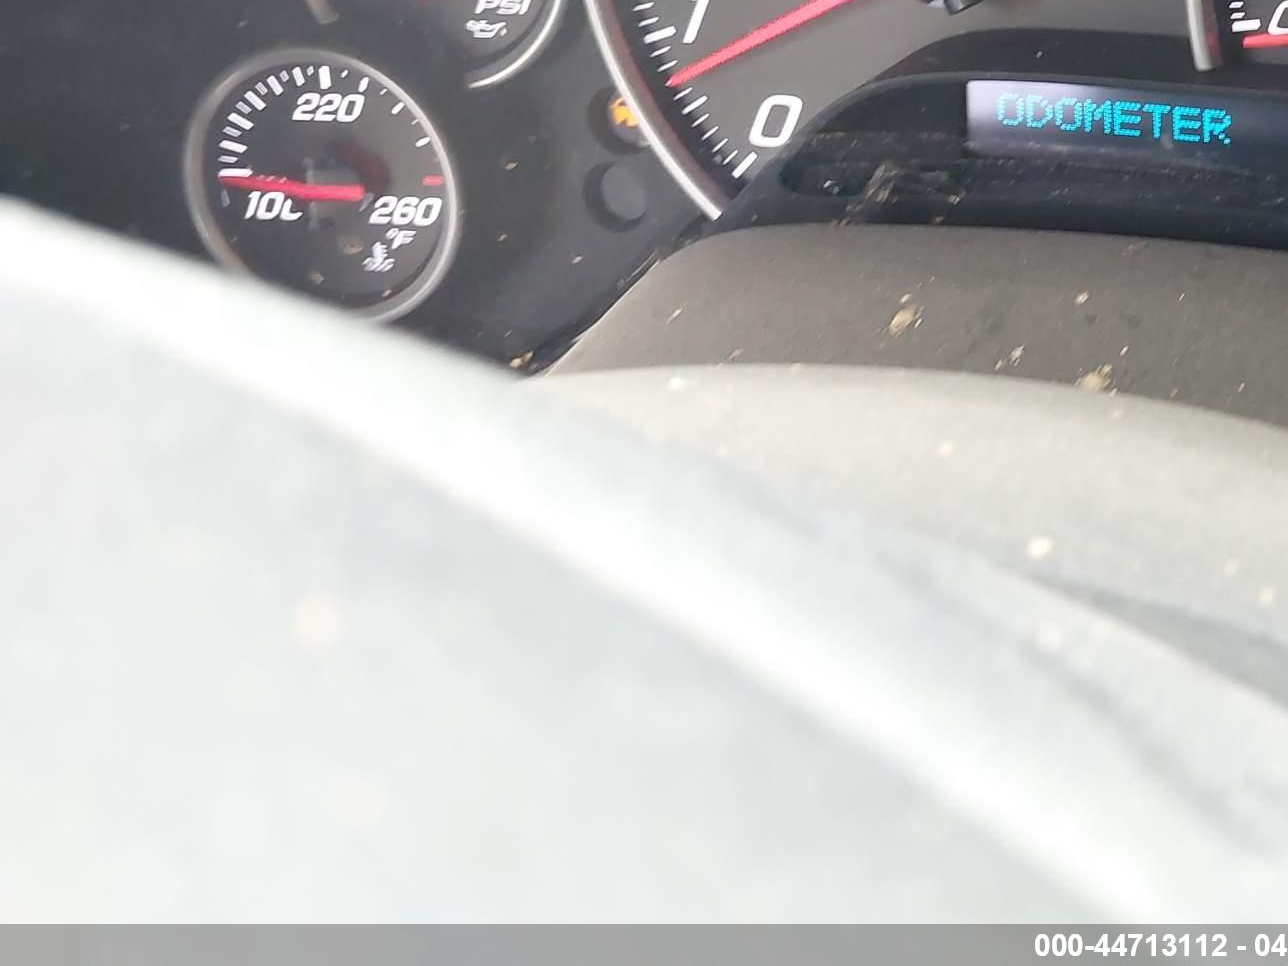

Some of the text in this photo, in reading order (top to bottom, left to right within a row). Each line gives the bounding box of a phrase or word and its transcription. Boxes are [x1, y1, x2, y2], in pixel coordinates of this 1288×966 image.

[291, 92, 366, 123] 220
[747, 94, 804, 149] 0
[997, 92, 1232, 146] ODOMETER
[368, 195, 443, 227] 260
